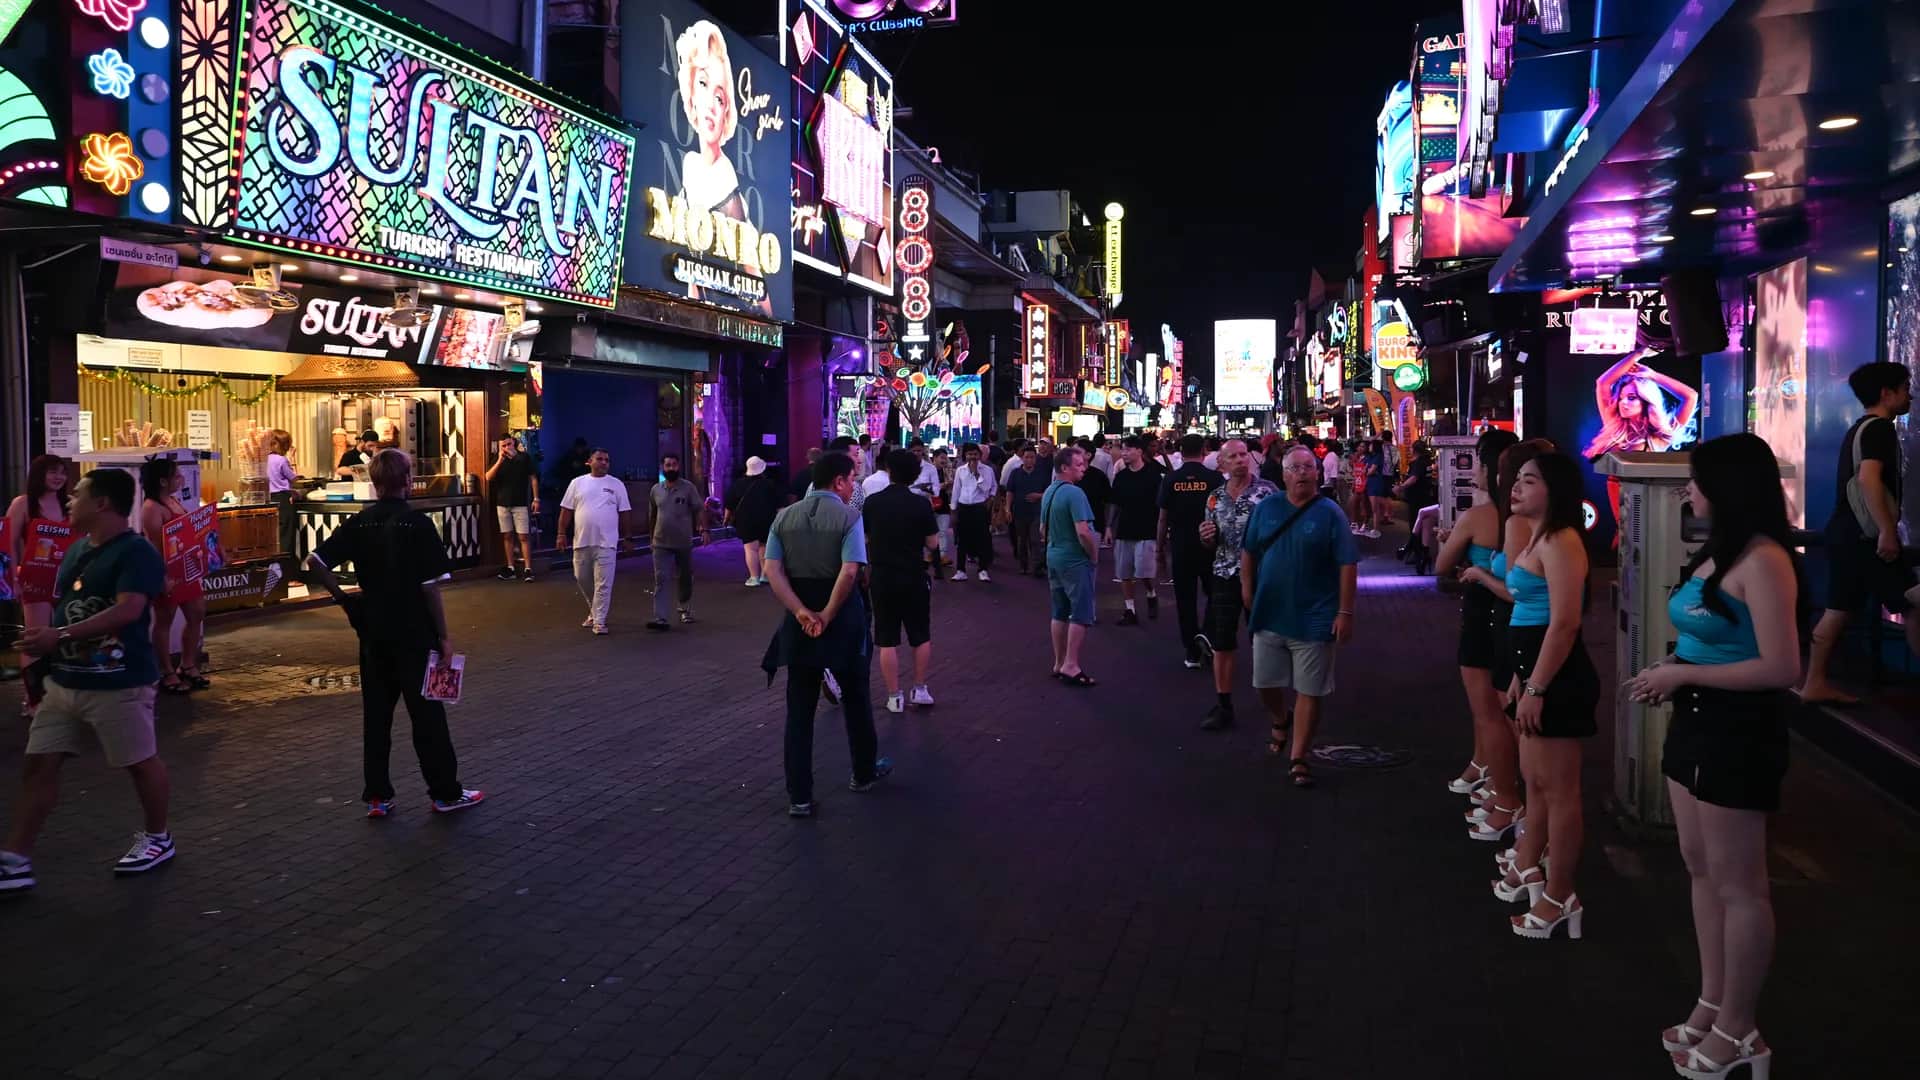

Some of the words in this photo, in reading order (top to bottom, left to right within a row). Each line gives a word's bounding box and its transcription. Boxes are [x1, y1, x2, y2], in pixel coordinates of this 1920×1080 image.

[868, 16, 924, 32] CLUBBING
[738, 67, 771, 118] Show
[756, 105, 784, 141] girls
[264, 45, 619, 256] SULTAN
[379, 226, 448, 265] TURKISH
[455, 245, 541, 278] RESTAURANT
[648, 187, 782, 275] MONRO
[677, 257, 730, 289] RUSSIAN
[733, 273, 765, 299] GIRLS
[1109, 239, 1119, 289] exchange
[1378, 336, 1413, 347] BURG
[1174, 482, 1207, 491] GUARD
[37, 524, 71, 536] GEISHA
